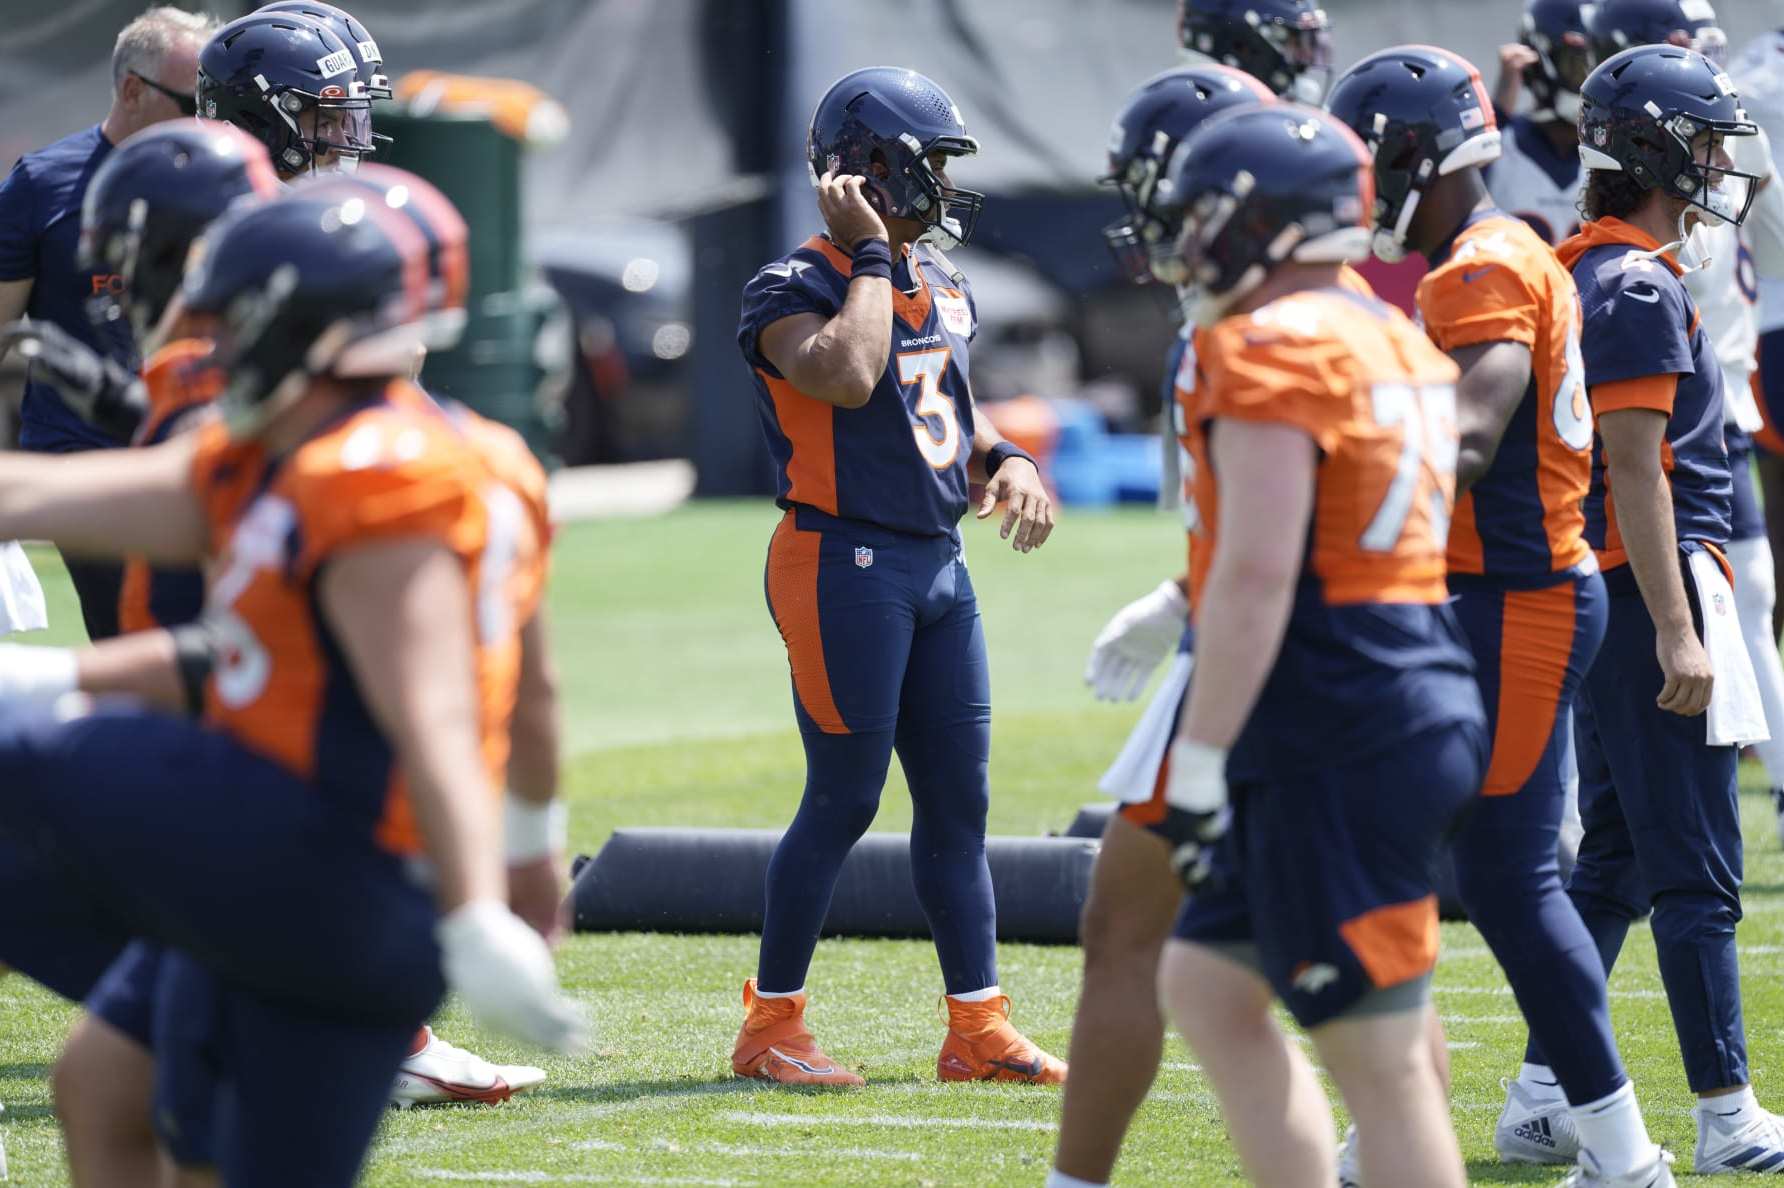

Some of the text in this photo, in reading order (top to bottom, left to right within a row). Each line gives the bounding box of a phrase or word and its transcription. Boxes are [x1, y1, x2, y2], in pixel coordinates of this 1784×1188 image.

[901, 335, 941, 347] BRONCOS
[896, 348, 959, 469] 3
[1514, 1128, 1556, 1148] adidas
